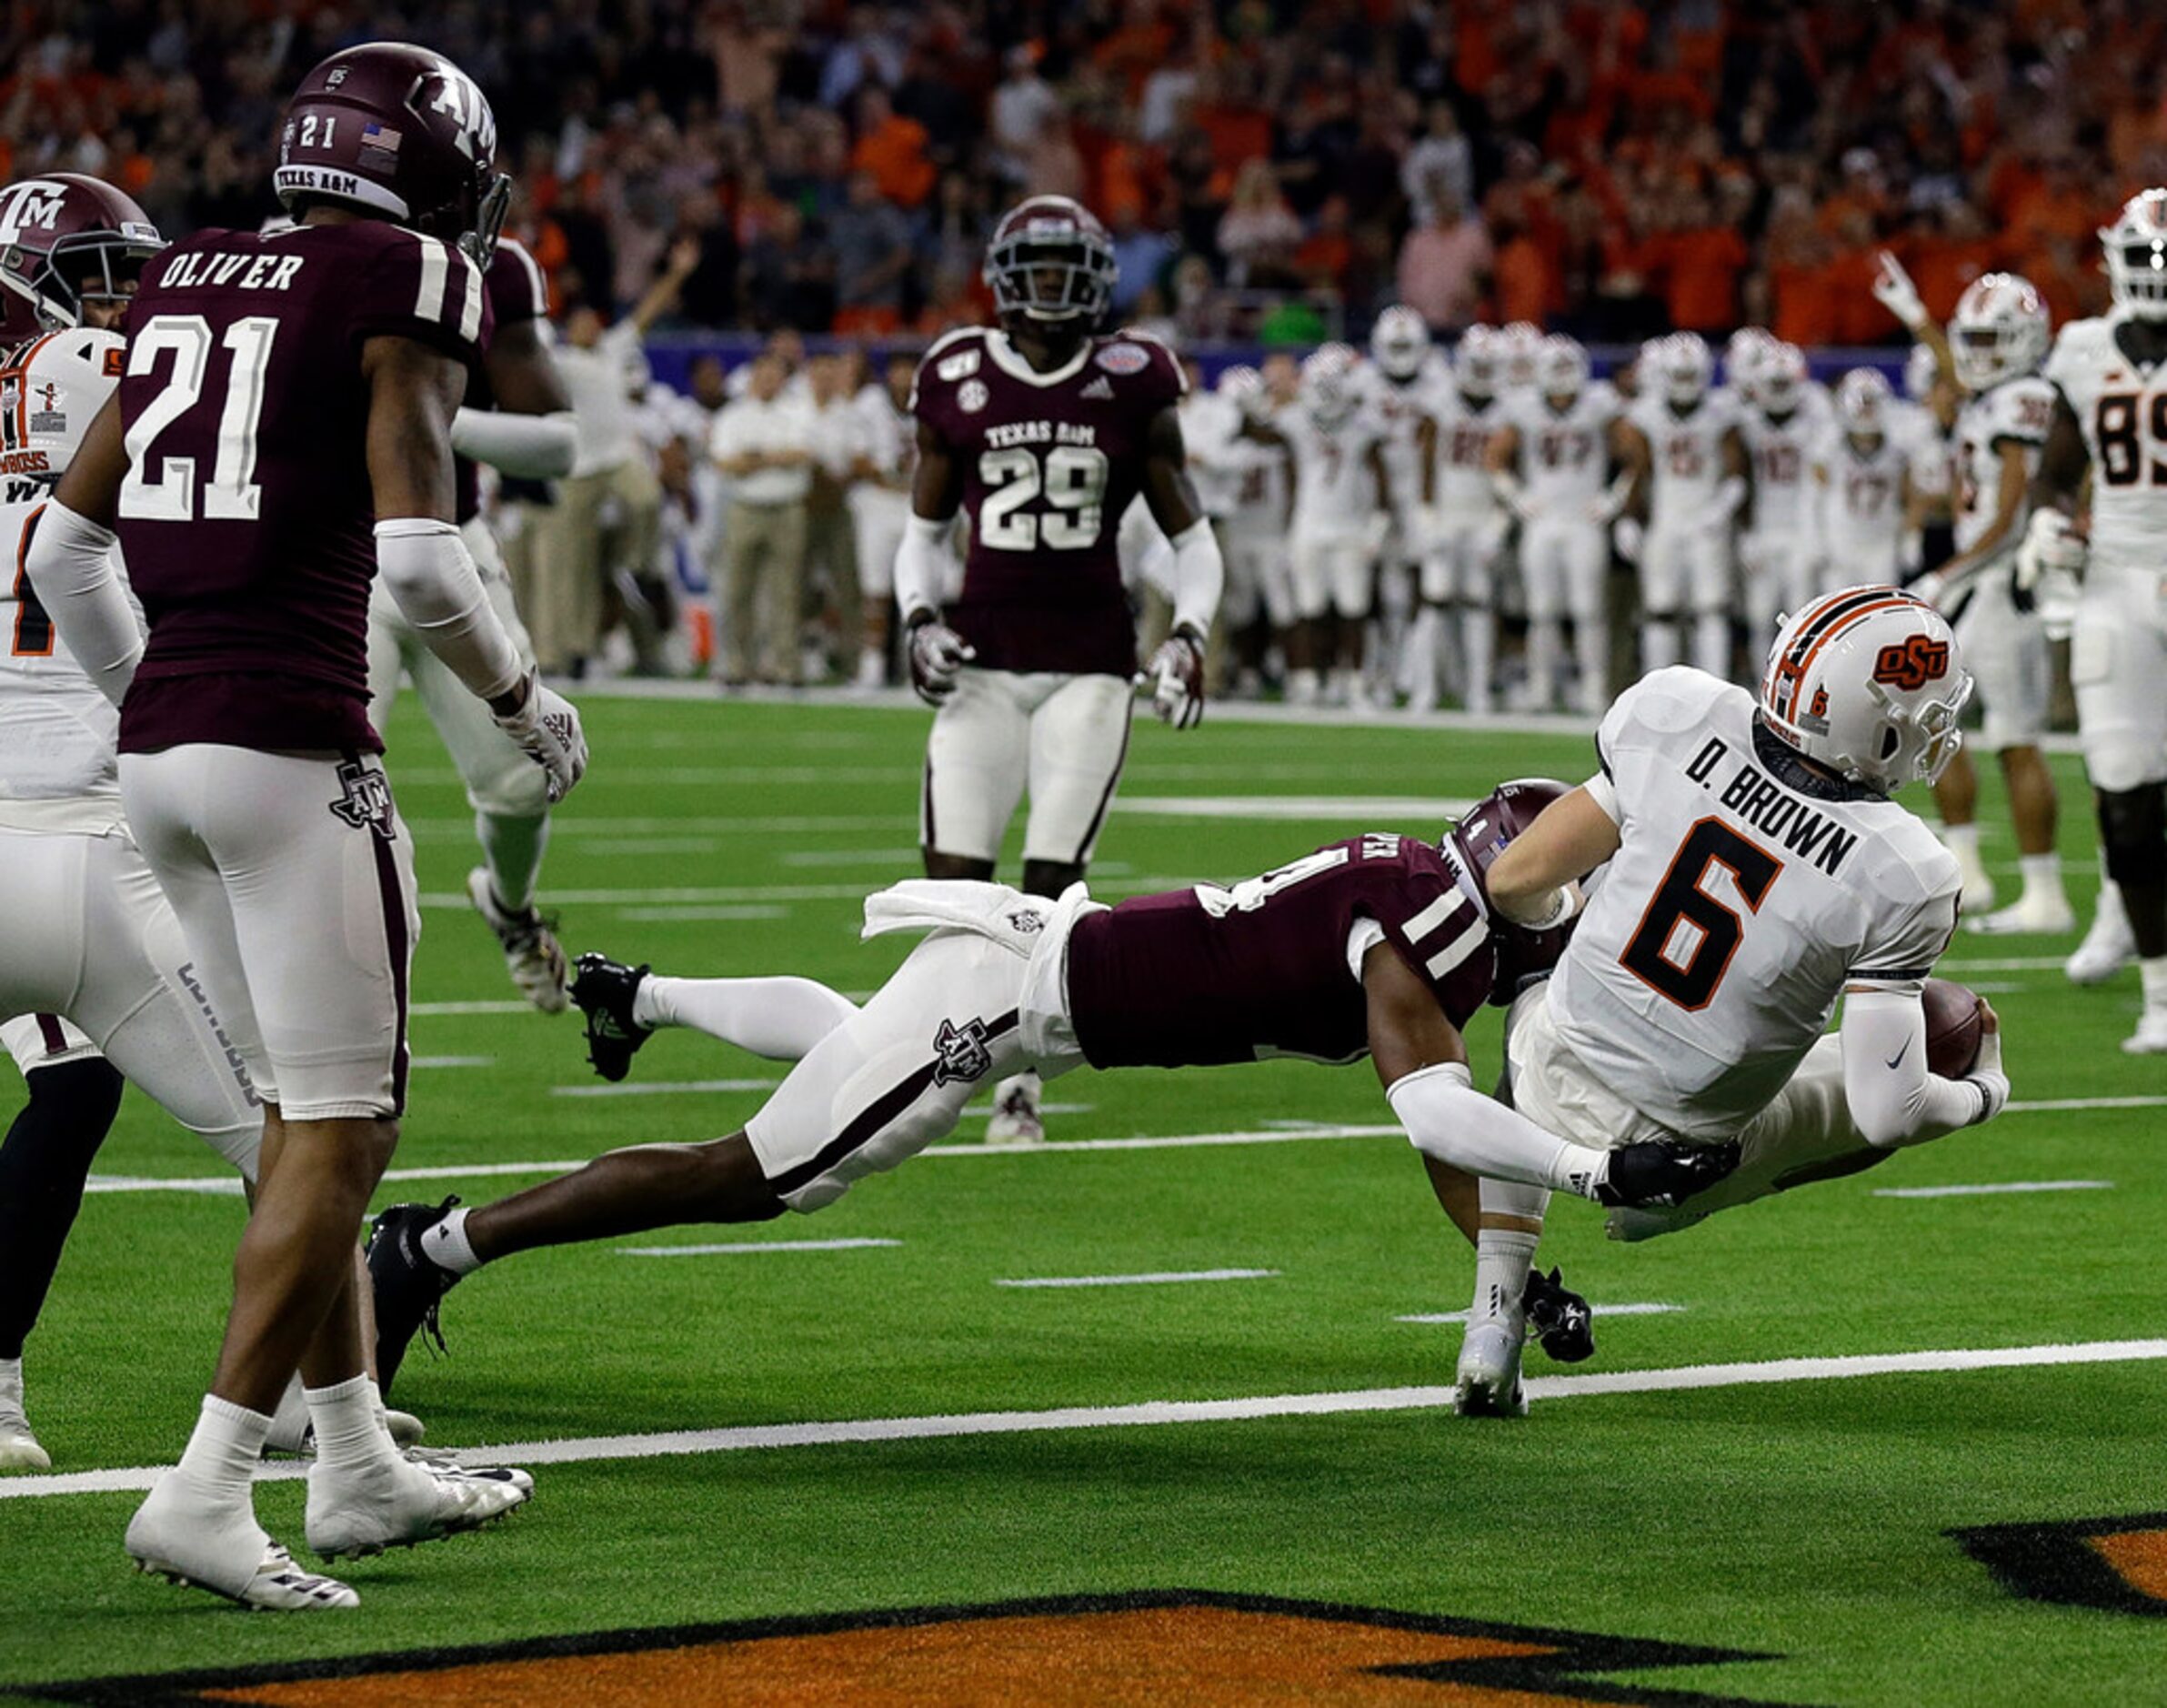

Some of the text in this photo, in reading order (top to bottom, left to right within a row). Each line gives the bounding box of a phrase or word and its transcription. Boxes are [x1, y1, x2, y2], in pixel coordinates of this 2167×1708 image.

[300, 115, 336, 149] 21
[276, 170, 357, 195] TEXAS A&M
[159, 252, 305, 292] OLIVER
[118, 314, 279, 522] 21
[984, 419, 1052, 449] TEXAS
[979, 446, 1109, 551] 29
[1873, 634, 1950, 691] OSU
[1811, 688, 1830, 718] 6
[1686, 736, 1860, 877] D. BROWN
[1619, 814, 1785, 1013] 6
